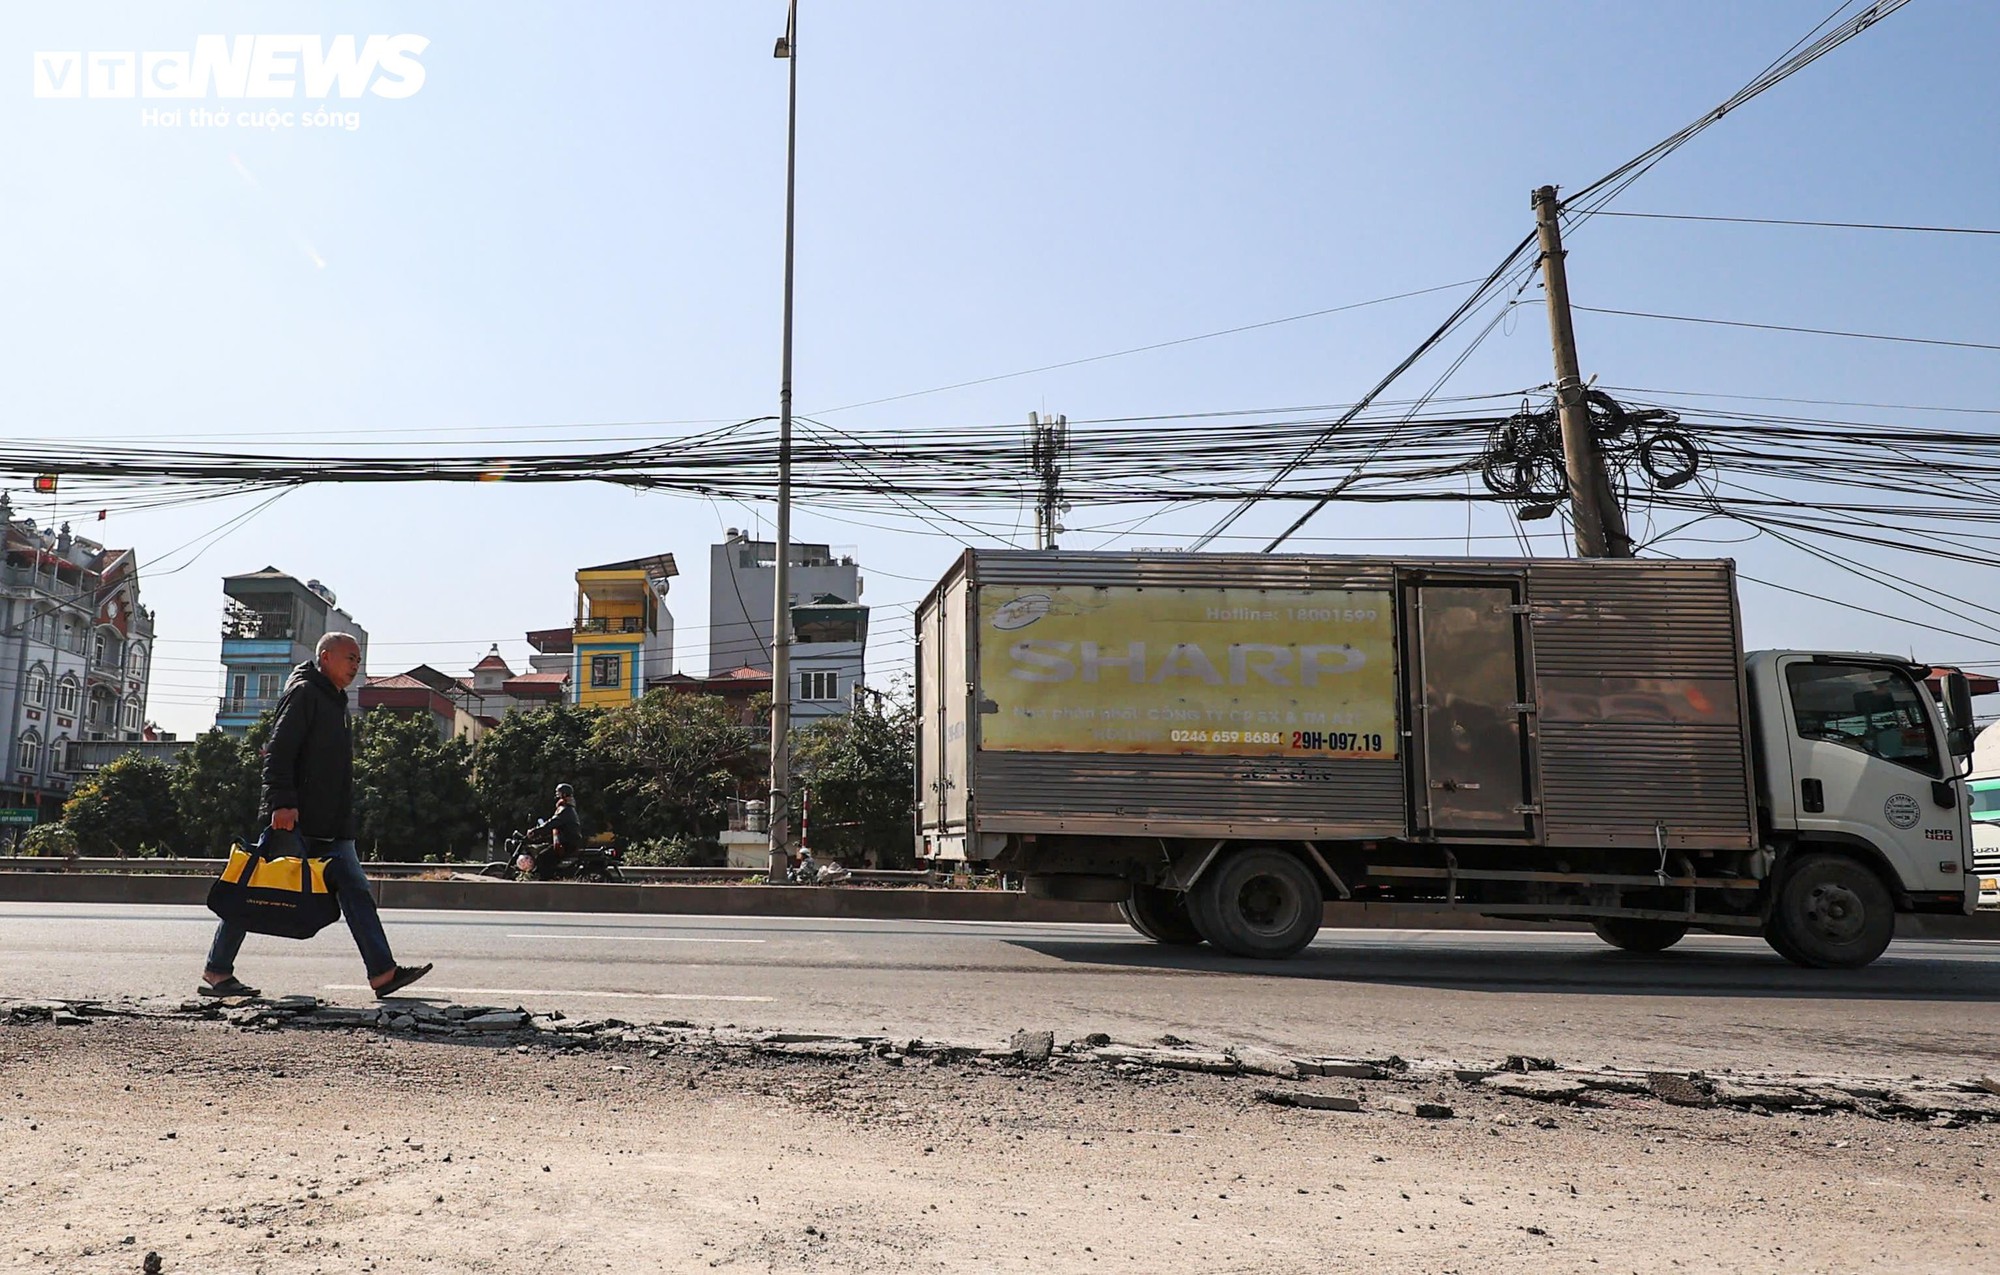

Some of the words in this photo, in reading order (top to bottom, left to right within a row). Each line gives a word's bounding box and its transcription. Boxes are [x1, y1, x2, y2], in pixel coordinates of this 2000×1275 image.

[1008, 638, 1367, 687] SHARP
[1170, 729, 1208, 743] 0246
[1211, 730, 1240, 743] 659
[1243, 731, 1281, 744] 8686
[1292, 731, 1382, 752] 29H-097.19
